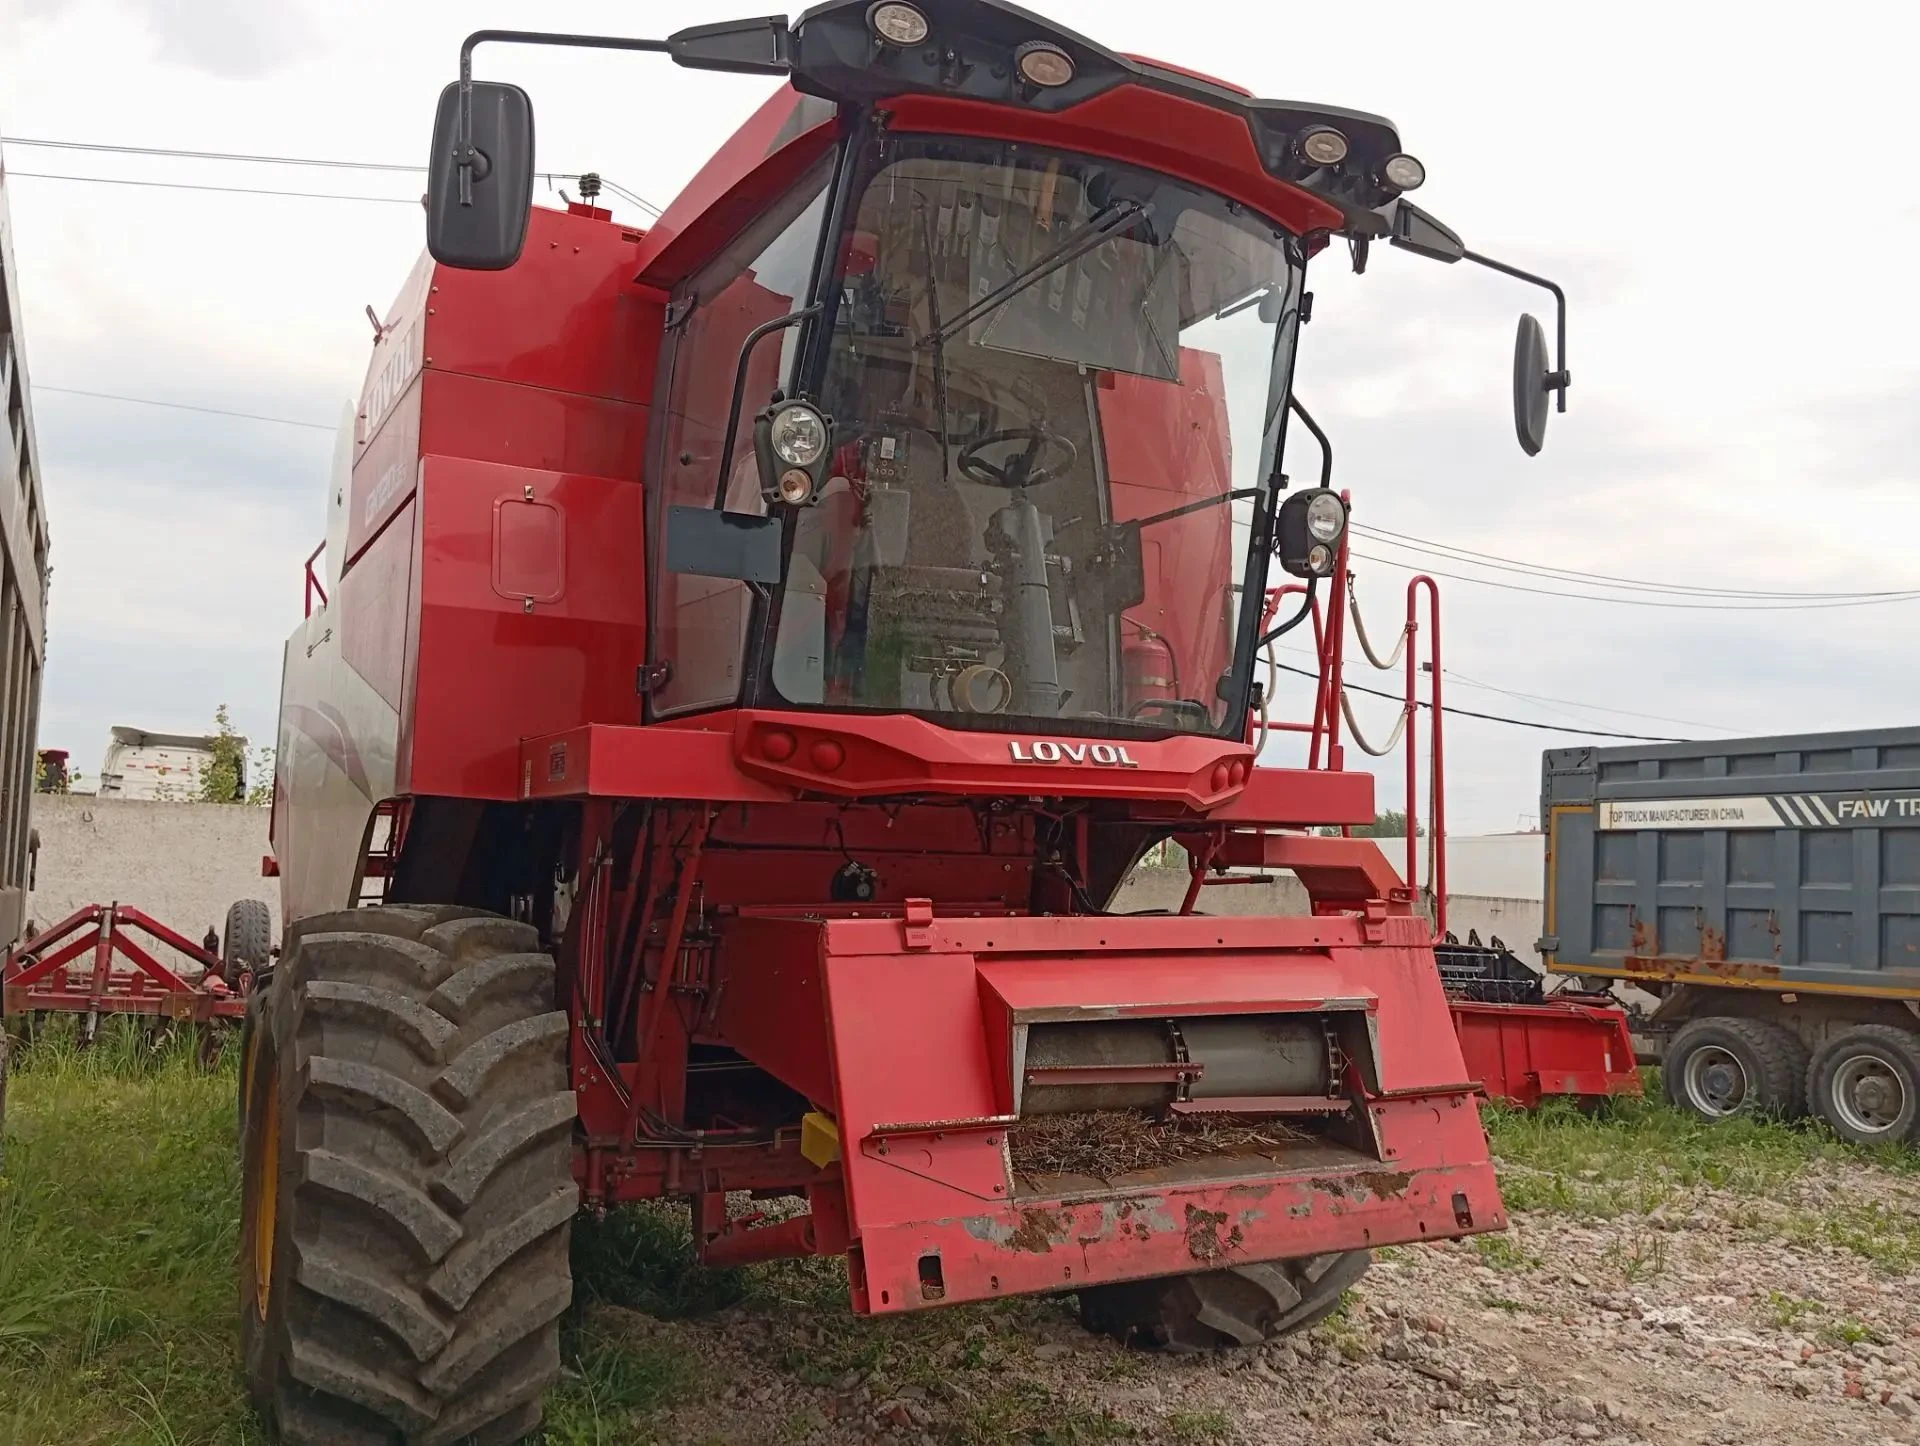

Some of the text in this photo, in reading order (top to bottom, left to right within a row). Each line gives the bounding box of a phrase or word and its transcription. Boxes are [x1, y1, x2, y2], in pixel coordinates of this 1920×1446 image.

[1008, 741, 1139, 768] LOVOL
[1609, 807, 1745, 823] TOP TRUCK MANUFACTURER IN CHINA
[1838, 799, 1890, 818] FAW
